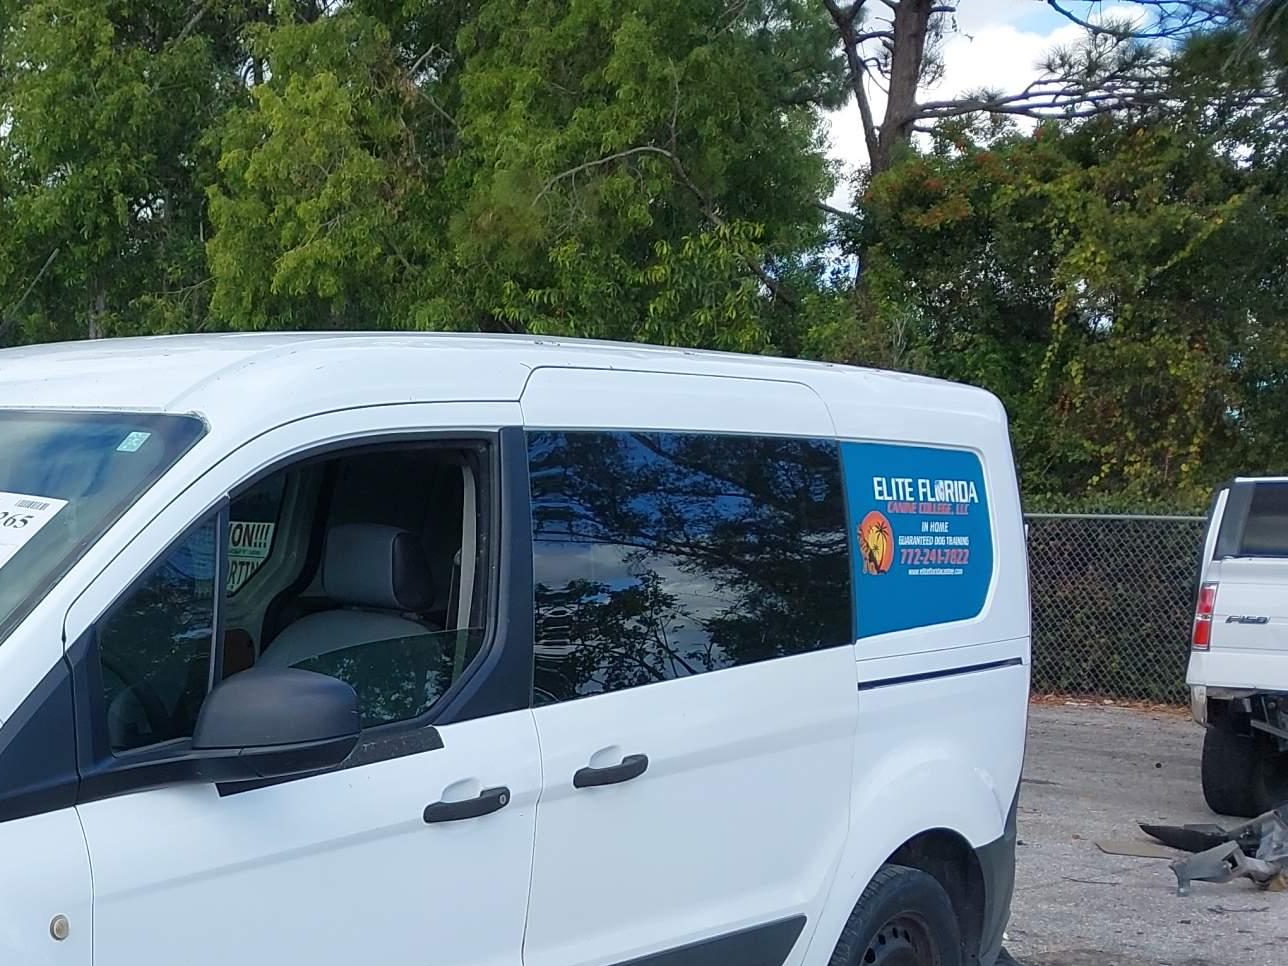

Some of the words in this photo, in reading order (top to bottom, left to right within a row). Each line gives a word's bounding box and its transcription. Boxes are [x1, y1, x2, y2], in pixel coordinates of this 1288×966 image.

[873, 477, 914, 501] ELITE
[918, 479, 978, 503] FLORIDA
[921, 521, 929, 533] IN
[929, 522, 949, 533] HOME
[898, 535, 934, 546] GUARANTEED
[934, 537, 946, 546] DOG
[946, 537, 970, 546] TRAINING
